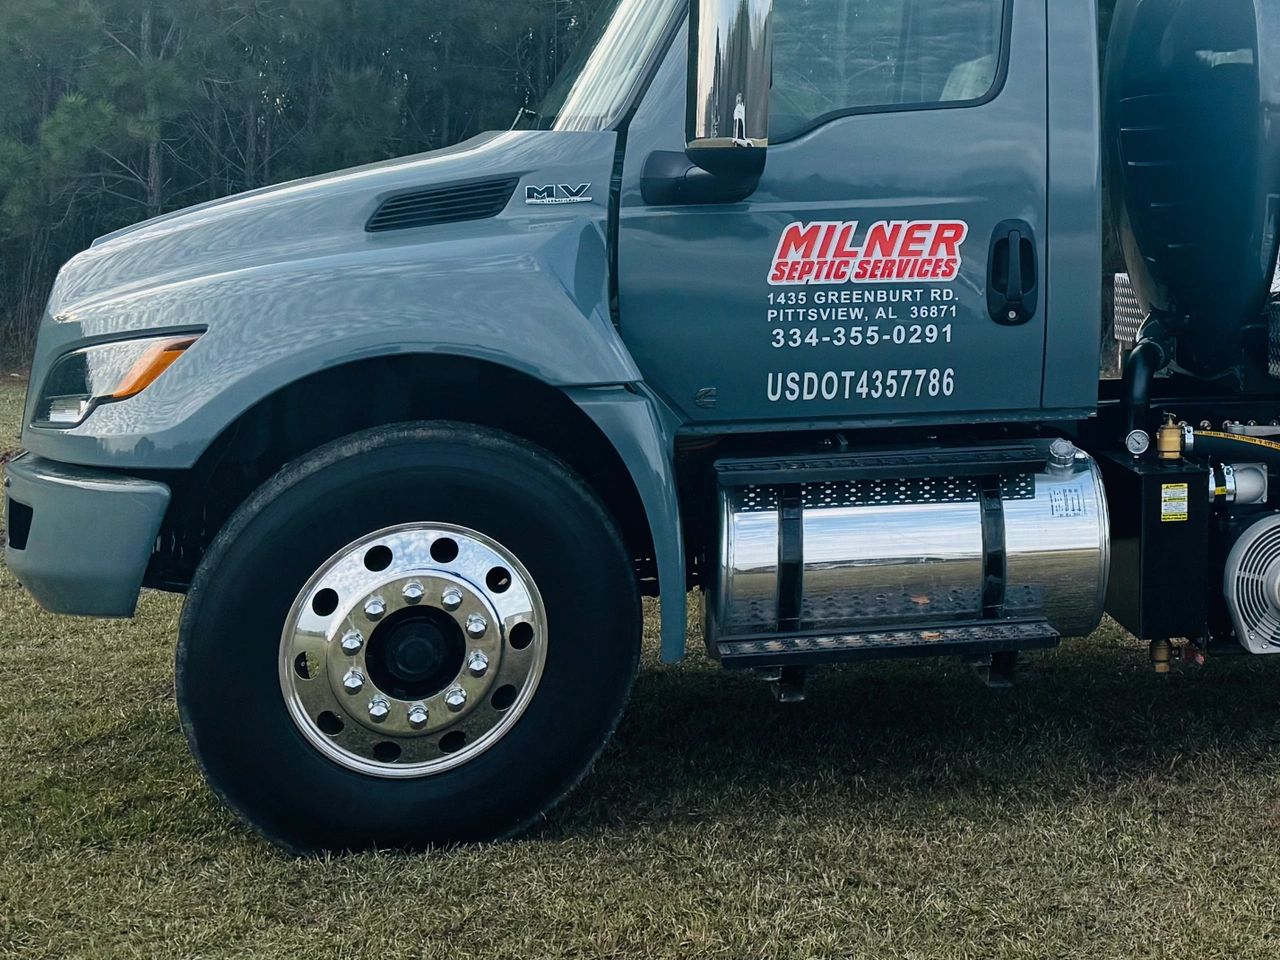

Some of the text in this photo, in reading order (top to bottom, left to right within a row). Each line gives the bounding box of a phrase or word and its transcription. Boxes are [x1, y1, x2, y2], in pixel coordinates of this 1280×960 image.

[525, 183, 591, 200] MV
[776, 222, 966, 260] MILNER
[770, 257, 958, 282] SEPTIC SERVICES
[767, 288, 959, 305] 1435 GREENBURT RD.
[767, 304, 957, 323] PITTSVIEW, AL 36871
[771, 323, 953, 348] 334-355-0291
[767, 368, 955, 402] USDOT4357786
